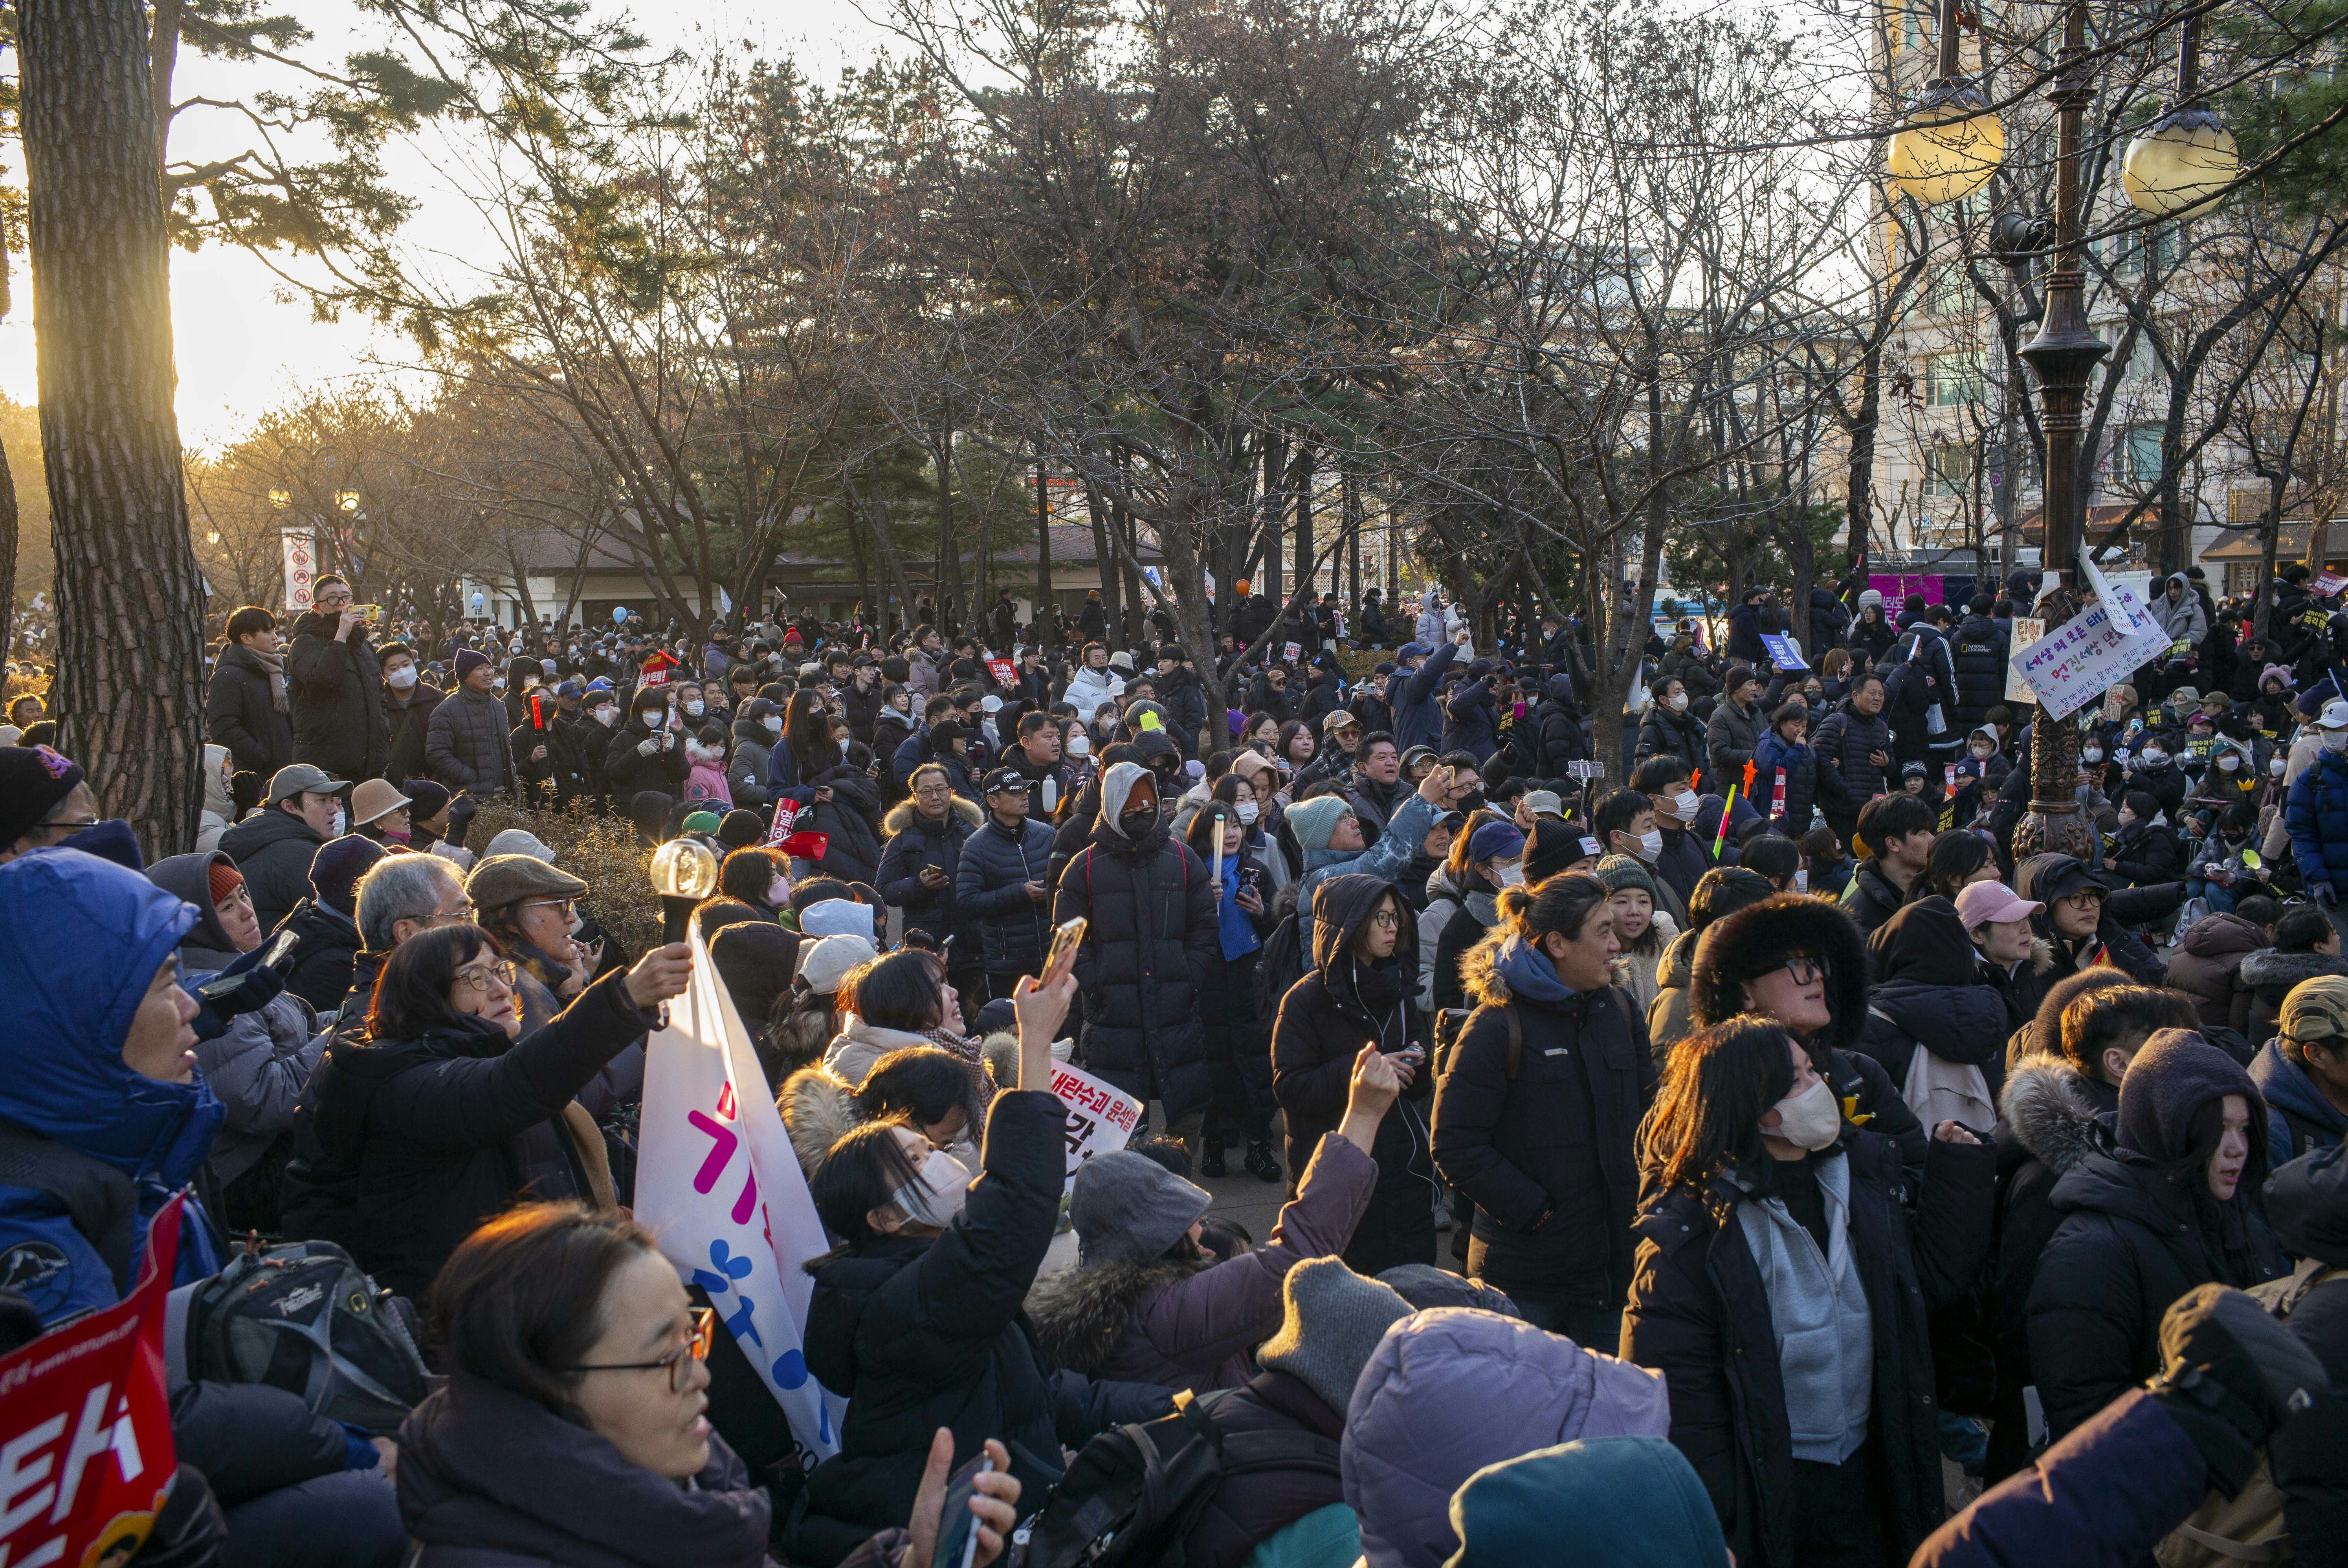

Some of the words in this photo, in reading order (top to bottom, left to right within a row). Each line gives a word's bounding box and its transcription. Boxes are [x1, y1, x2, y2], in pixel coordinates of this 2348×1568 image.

[2018, 620, 2040, 643] 탄핵
[2066, 624, 2087, 644] 모든
[987, 784, 1001, 794] PING
[1051, 1069, 1112, 1115] 내란수괴
[1105, 1099, 1138, 1133] 윤석열
[1066, 1112, 1097, 1155] 각
